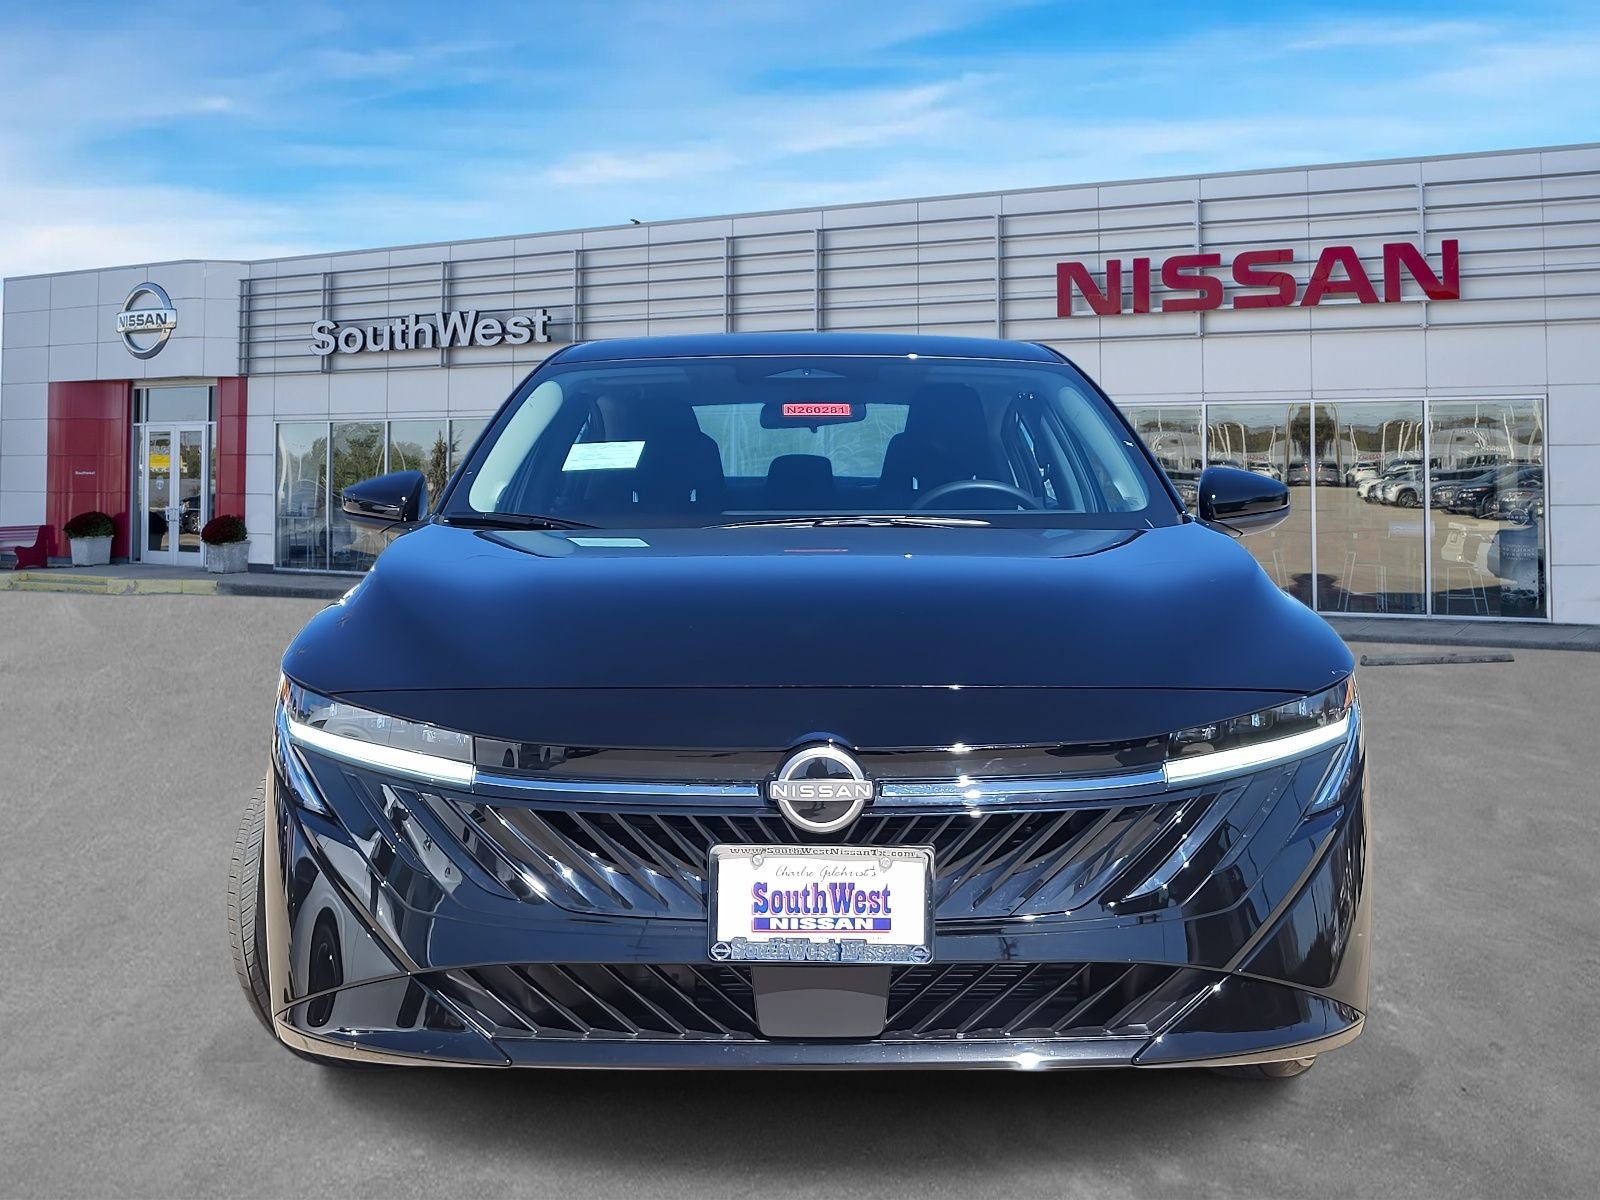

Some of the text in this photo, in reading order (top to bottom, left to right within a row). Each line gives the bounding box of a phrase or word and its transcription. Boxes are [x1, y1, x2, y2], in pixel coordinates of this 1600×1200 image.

[1056, 239, 1461, 317] NISSAN
[119, 313, 167, 328] NISSAN
[309, 309, 552, 357] SouthWest
[787, 406, 845, 414] N260281
[772, 783, 871, 798] NISSAN
[752, 882, 891, 915] SouthWest
[769, 917, 874, 930] NISSAN
